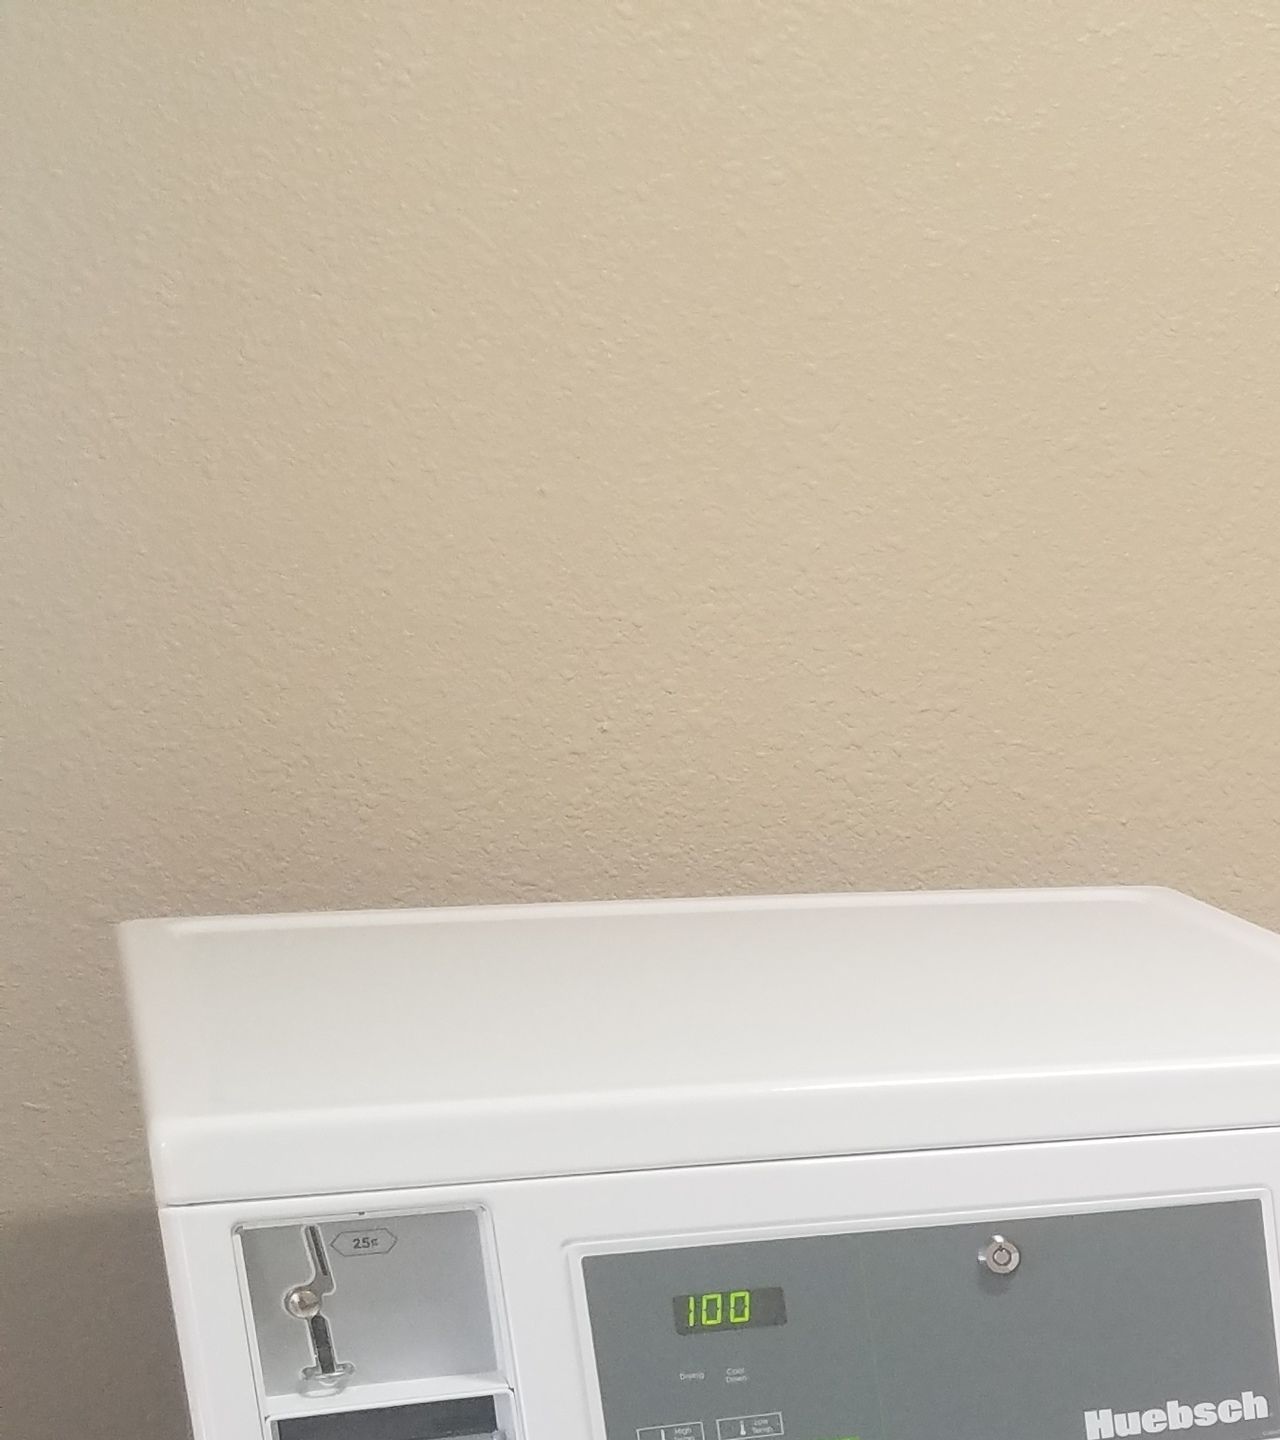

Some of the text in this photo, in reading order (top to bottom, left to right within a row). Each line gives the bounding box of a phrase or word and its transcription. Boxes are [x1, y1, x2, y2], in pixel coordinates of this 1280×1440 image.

[688, 1291, 750, 1327] 100
[680, 1372, 705, 1381] Drying
[1084, 1391, 1269, 1440] Huebsch
[674, 1427, 692, 1435] High
